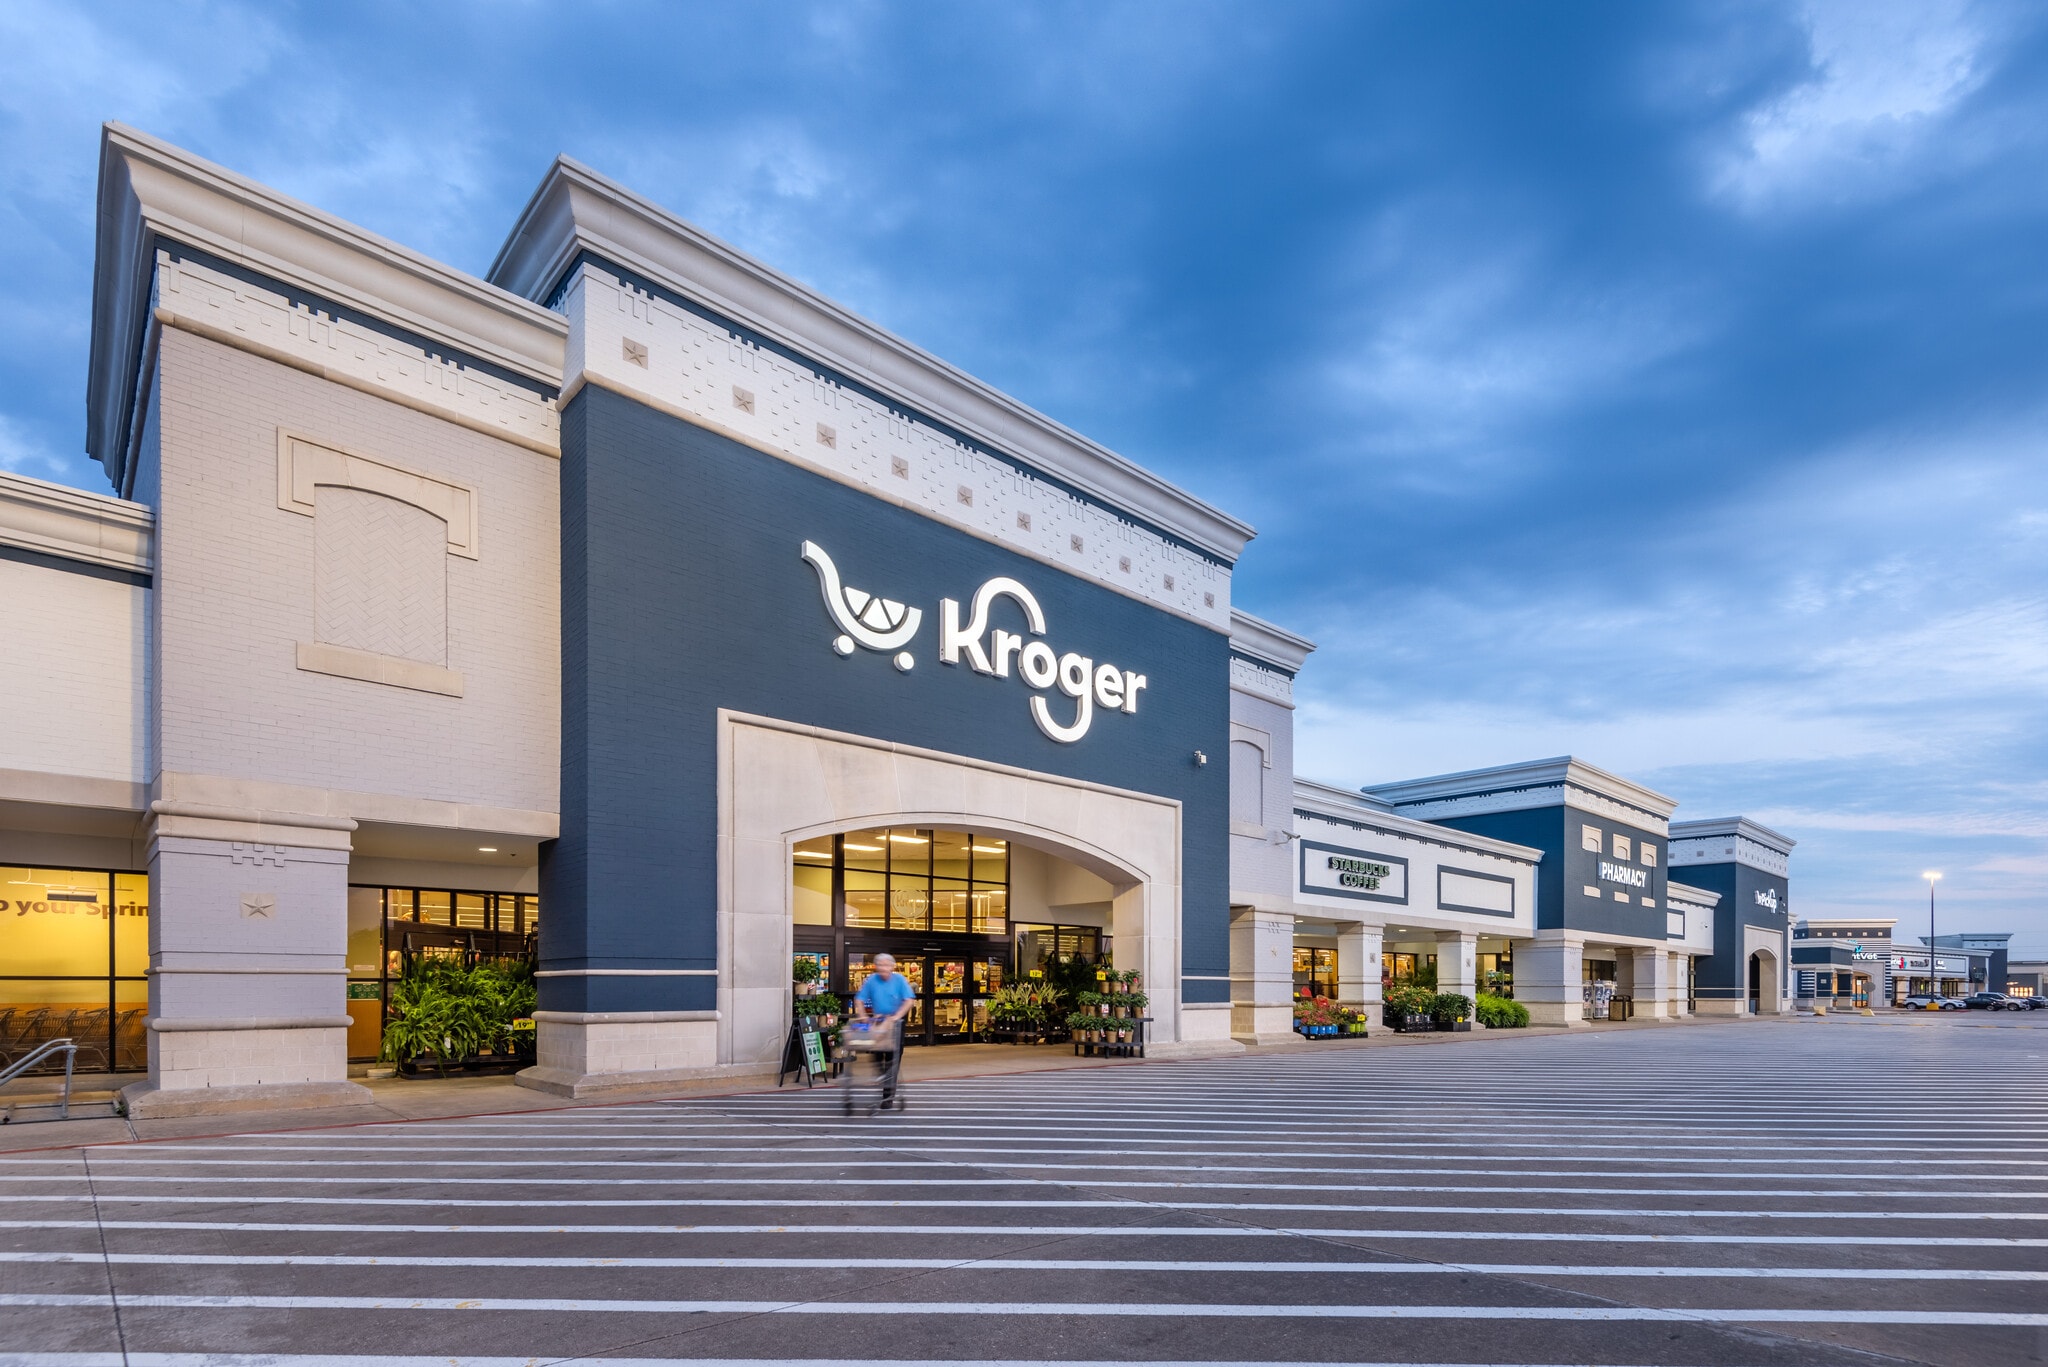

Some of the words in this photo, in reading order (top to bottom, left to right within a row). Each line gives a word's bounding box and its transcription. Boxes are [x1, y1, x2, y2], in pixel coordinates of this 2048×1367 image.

[940, 577, 1146, 743] Kroger
[1328, 857, 1390, 877] STARBUCKS
[1599, 861, 1647, 888] PHARMACY
[1340, 873, 1381, 890] COFFEE
[16, 900, 79, 916] your
[86, 900, 149, 919] Sprin
